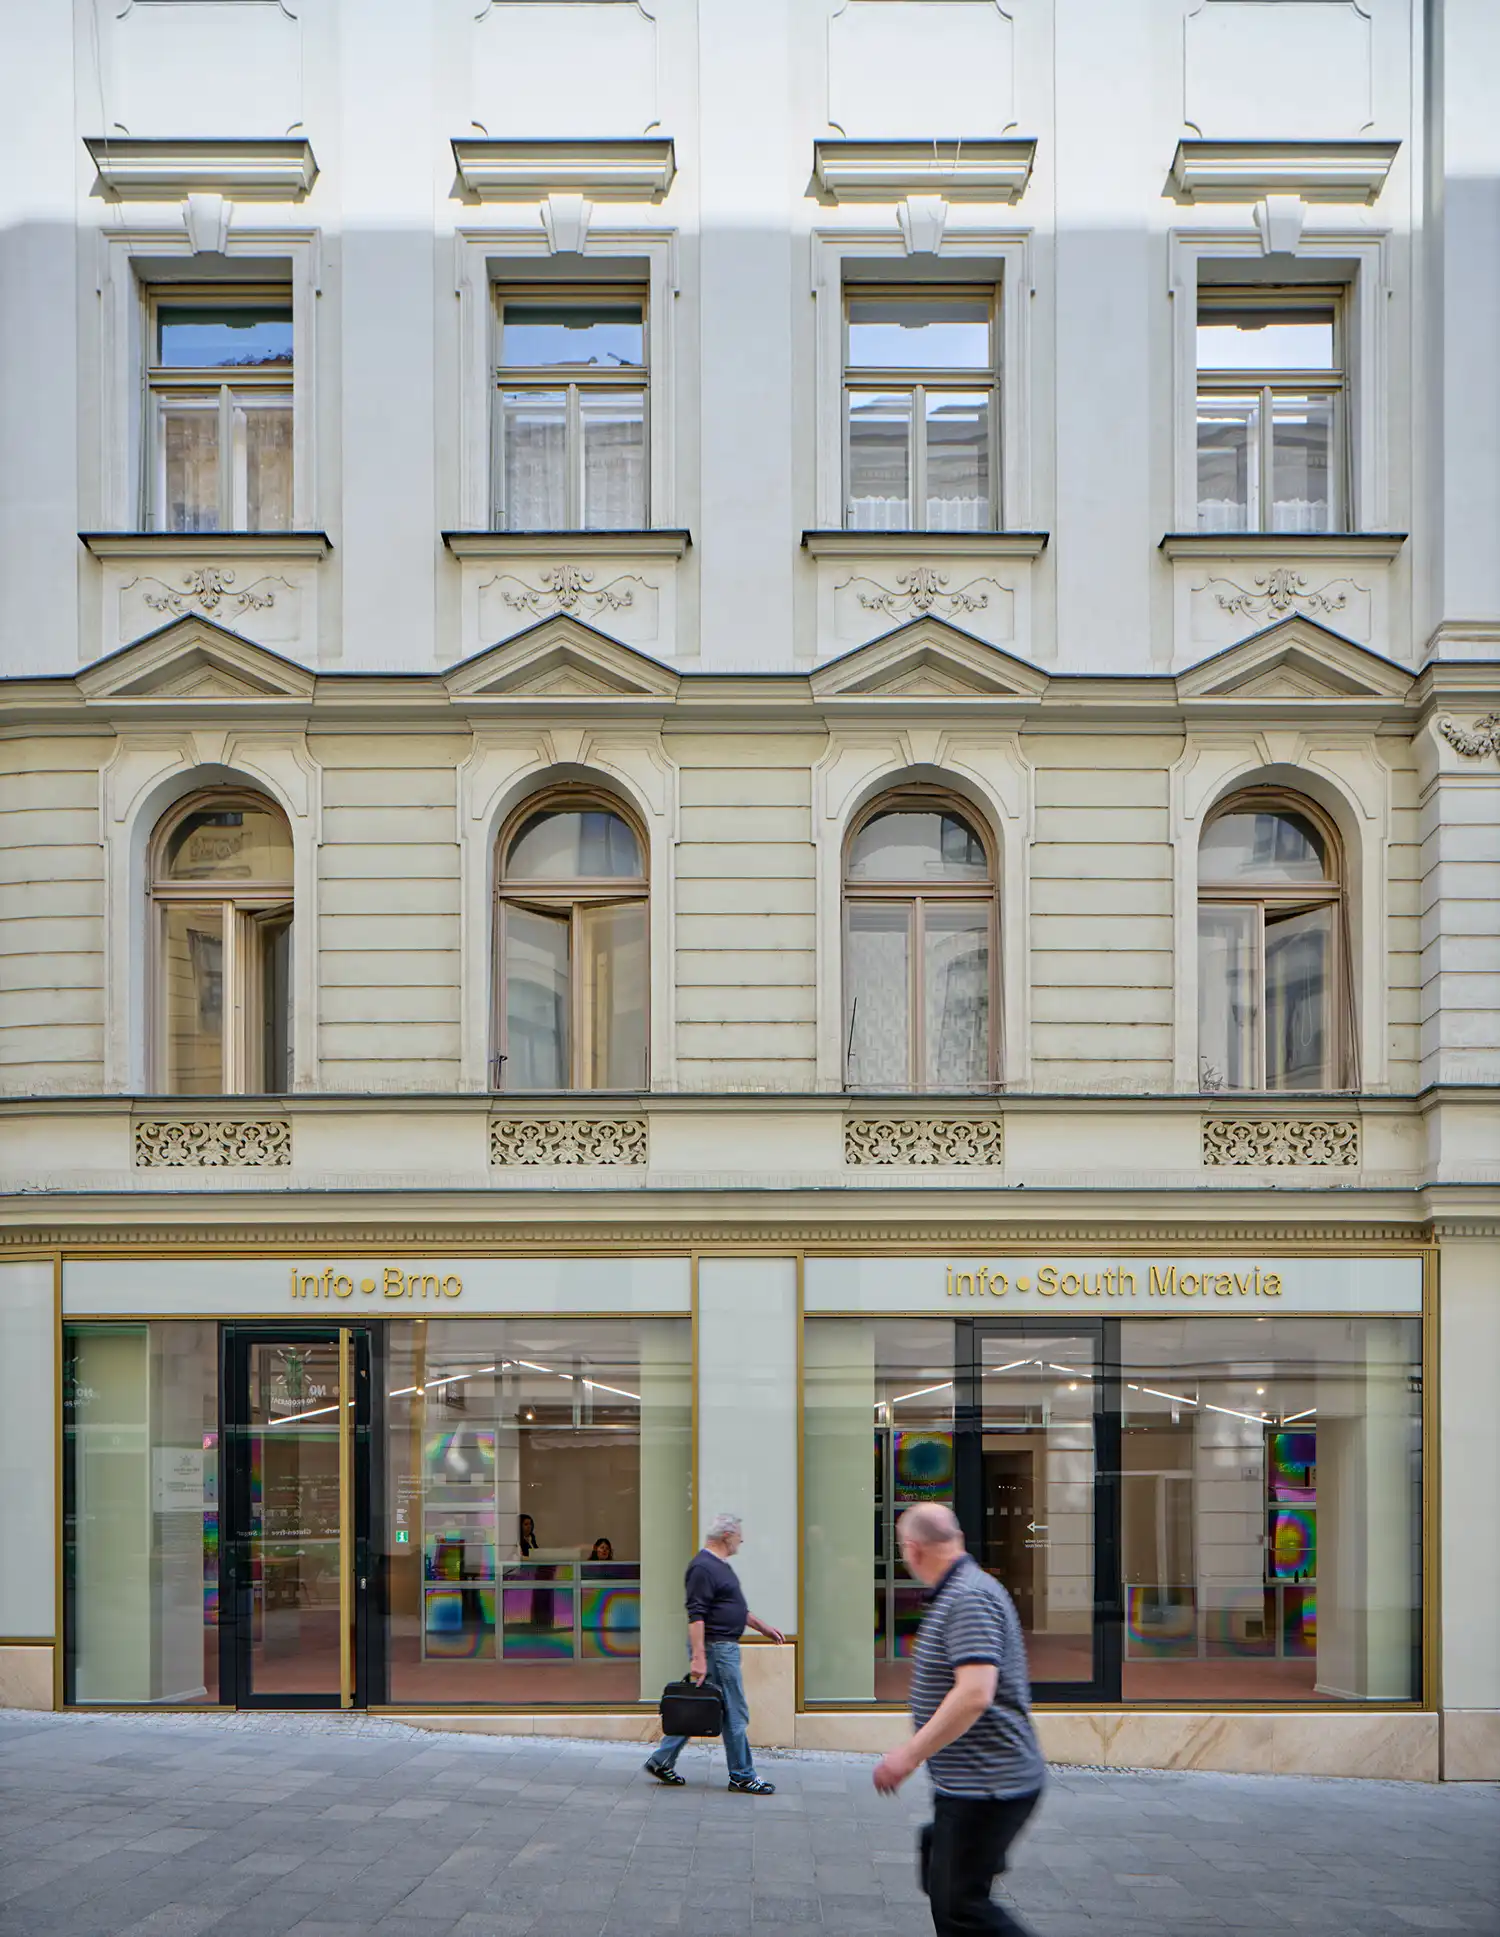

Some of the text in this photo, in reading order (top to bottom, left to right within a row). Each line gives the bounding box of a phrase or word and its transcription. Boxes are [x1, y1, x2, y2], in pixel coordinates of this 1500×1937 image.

[291, 1267, 463, 1298] info Brno
[947, 1264, 1283, 1297] info South Moravia
